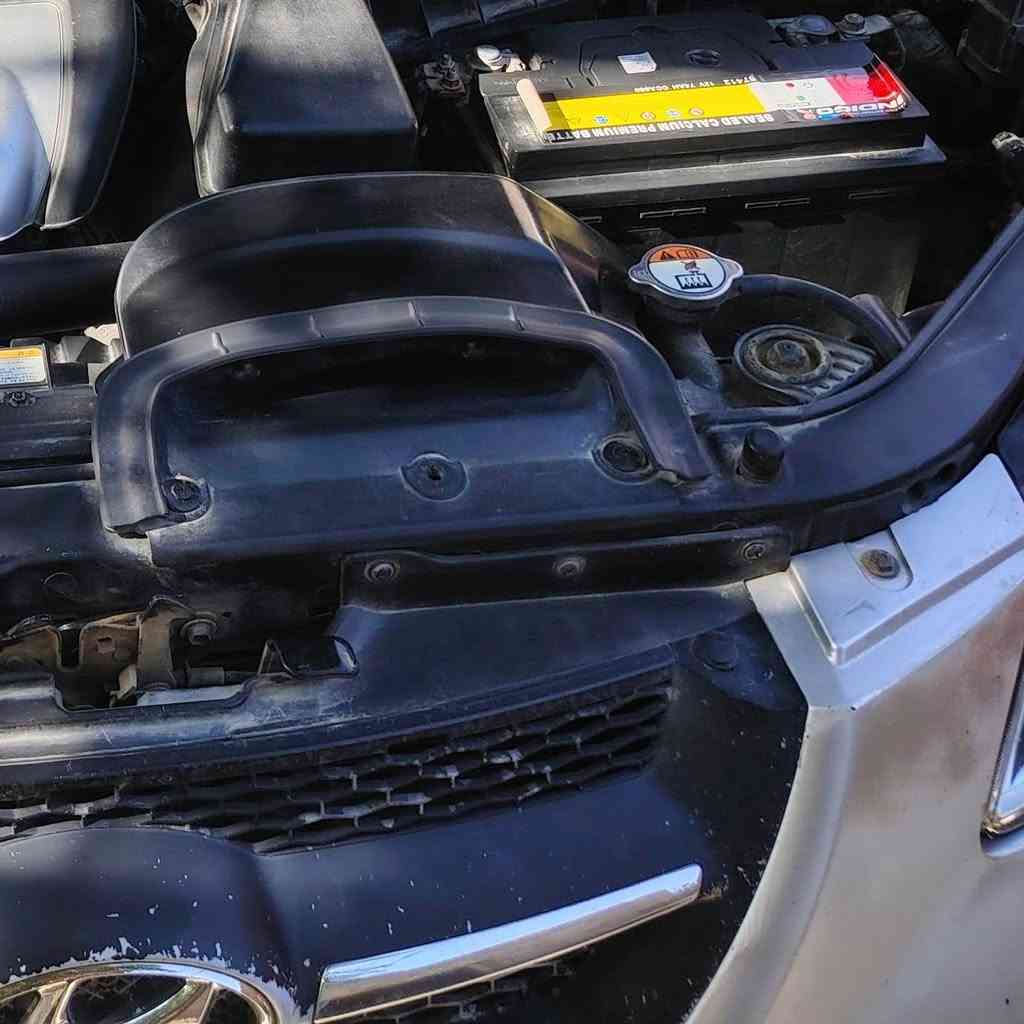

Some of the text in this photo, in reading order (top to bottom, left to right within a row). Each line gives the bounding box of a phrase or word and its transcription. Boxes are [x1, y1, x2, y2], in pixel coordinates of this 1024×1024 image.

[659, 118, 720, 132] CALCIUM
[721, 113, 774, 127] SEALED
[592, 125, 657, 138] PREMIUM
